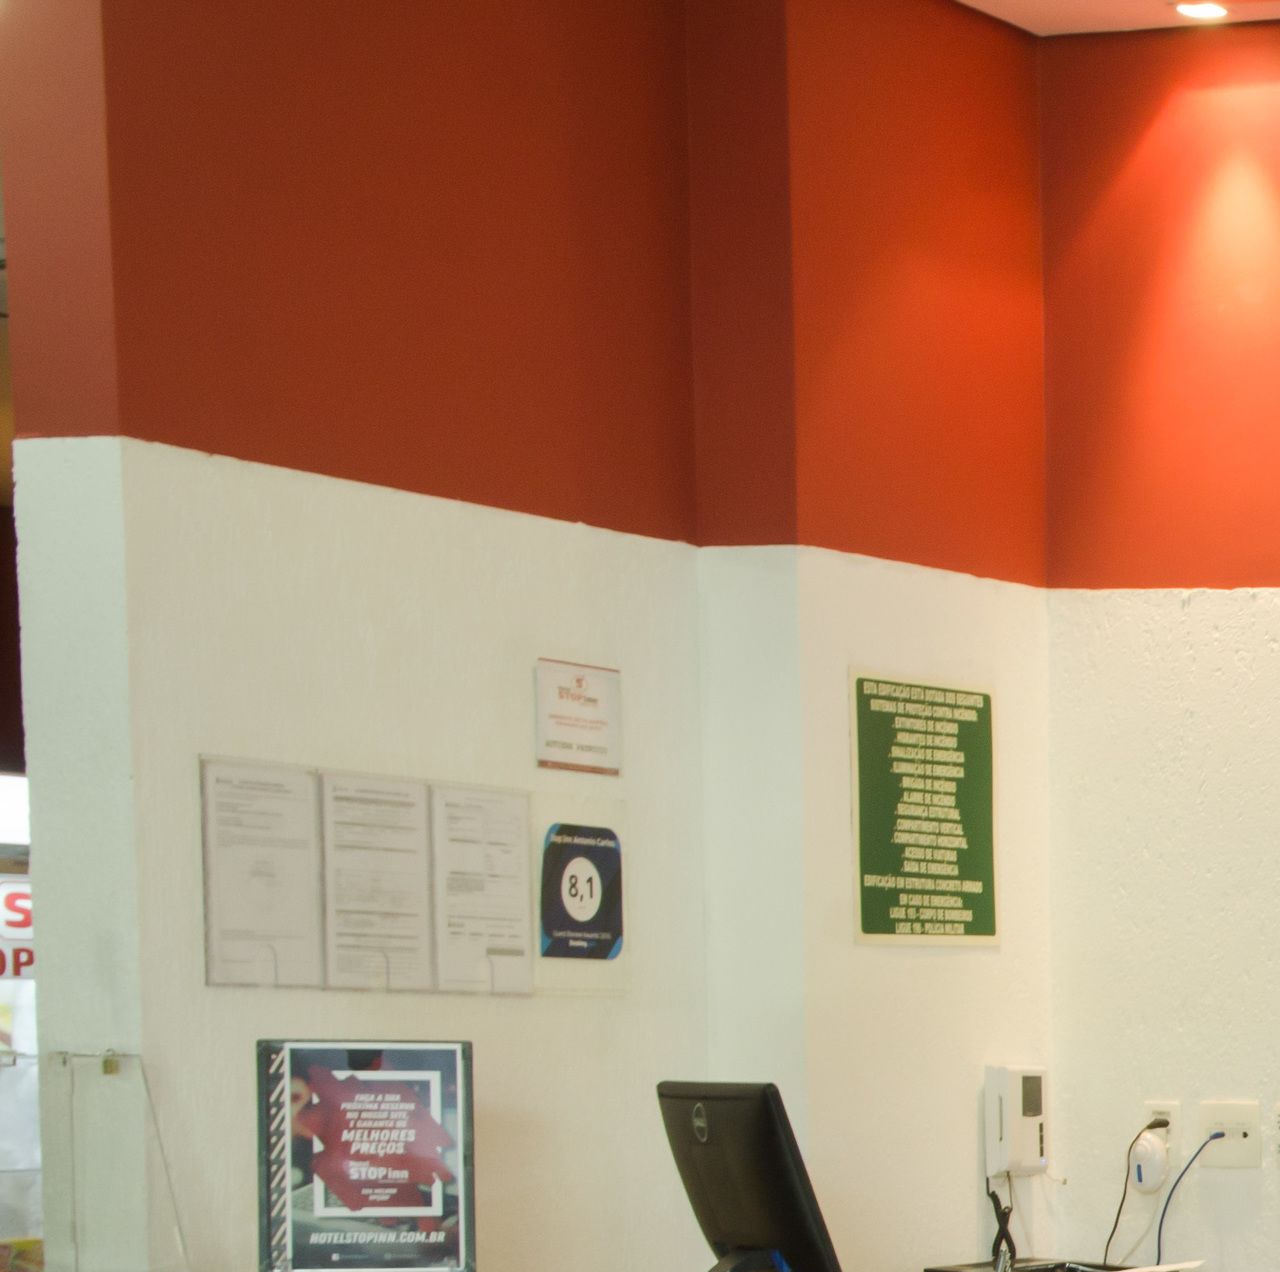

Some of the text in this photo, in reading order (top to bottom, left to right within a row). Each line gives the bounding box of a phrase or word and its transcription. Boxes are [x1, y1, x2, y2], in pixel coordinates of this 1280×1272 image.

[568, 874, 593, 902] 8,1
[342, 1129, 416, 1142] MELHORES
[351, 1142, 405, 1157] PREÇOS
[350, 1166, 387, 1180] STOP
[309, 1231, 446, 1245] HOTELSTOPINN.COM.BR
